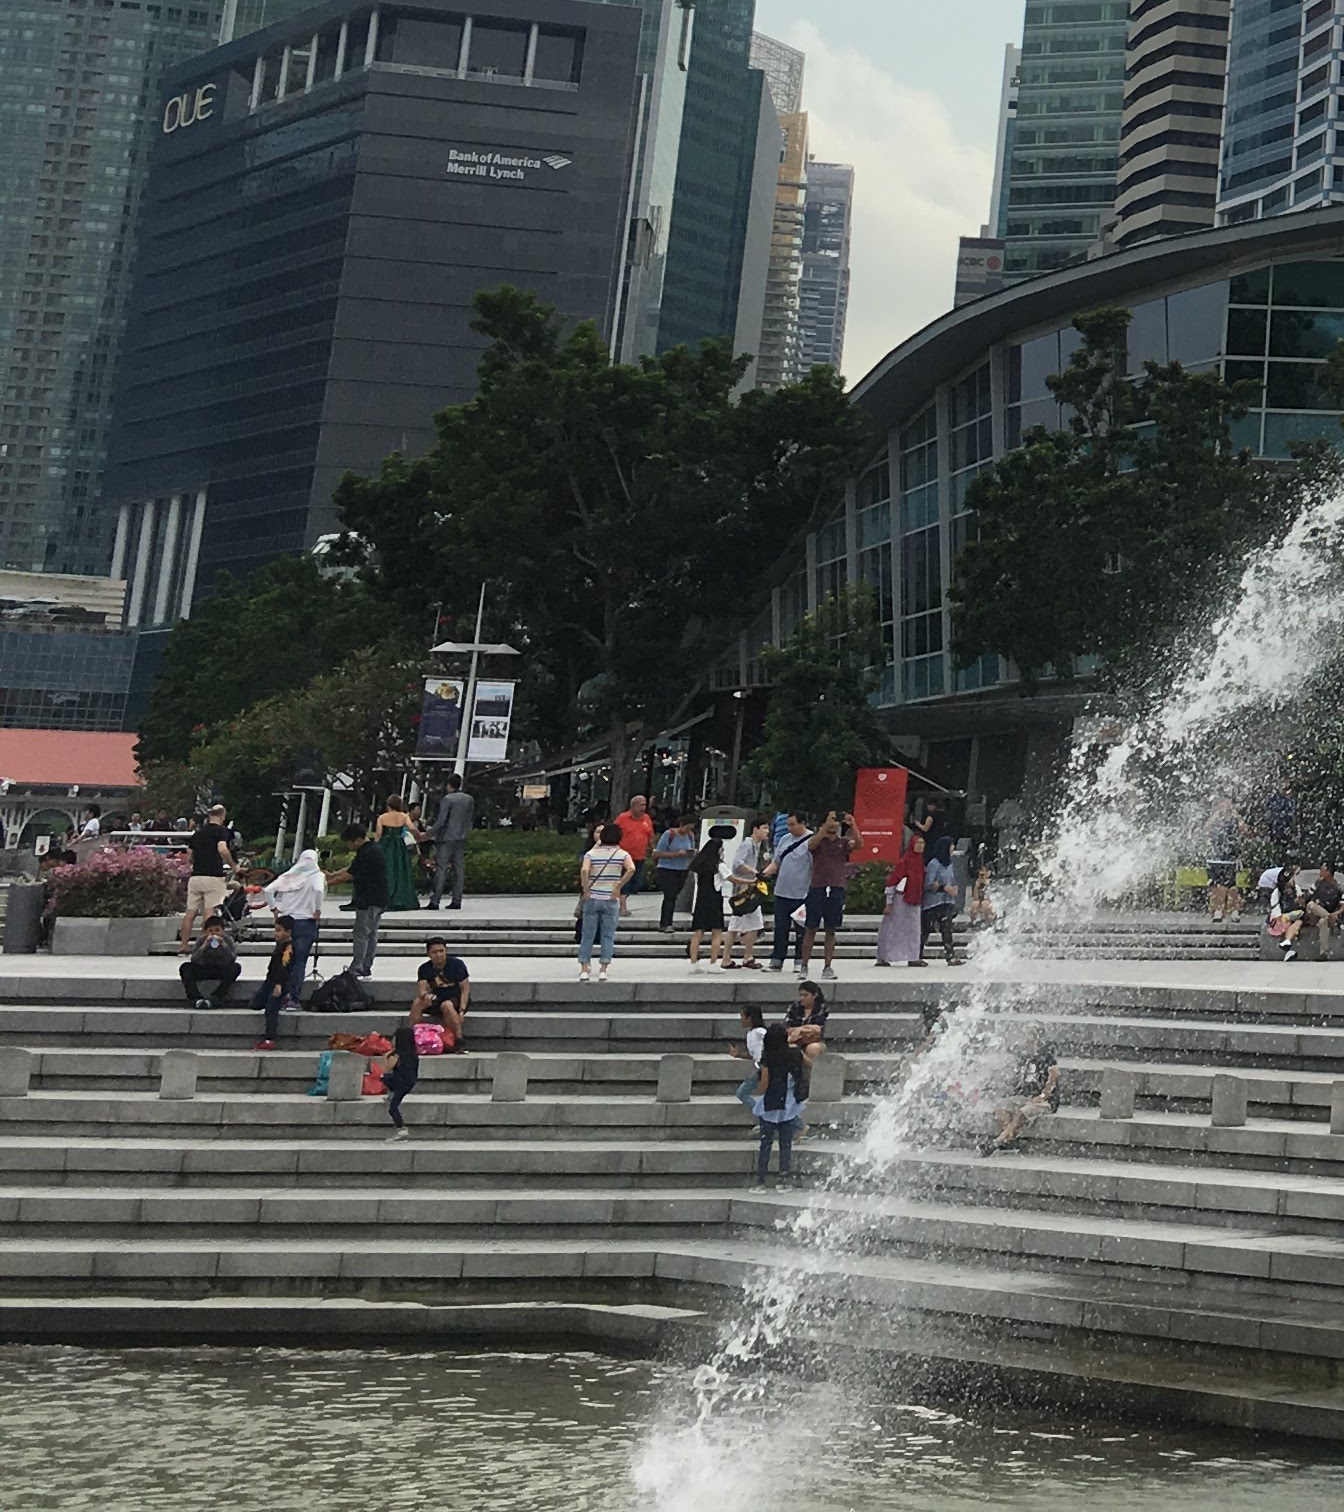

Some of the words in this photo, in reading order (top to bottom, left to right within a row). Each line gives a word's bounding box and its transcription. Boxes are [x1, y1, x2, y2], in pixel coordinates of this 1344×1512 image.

[163, 83, 217, 134] OUE
[448, 149, 478, 163] Bank
[479, 153, 493, 164] of
[492, 153, 541, 169] America
[446, 162, 487, 177] Merrill
[489, 166, 525, 180] Lynch
